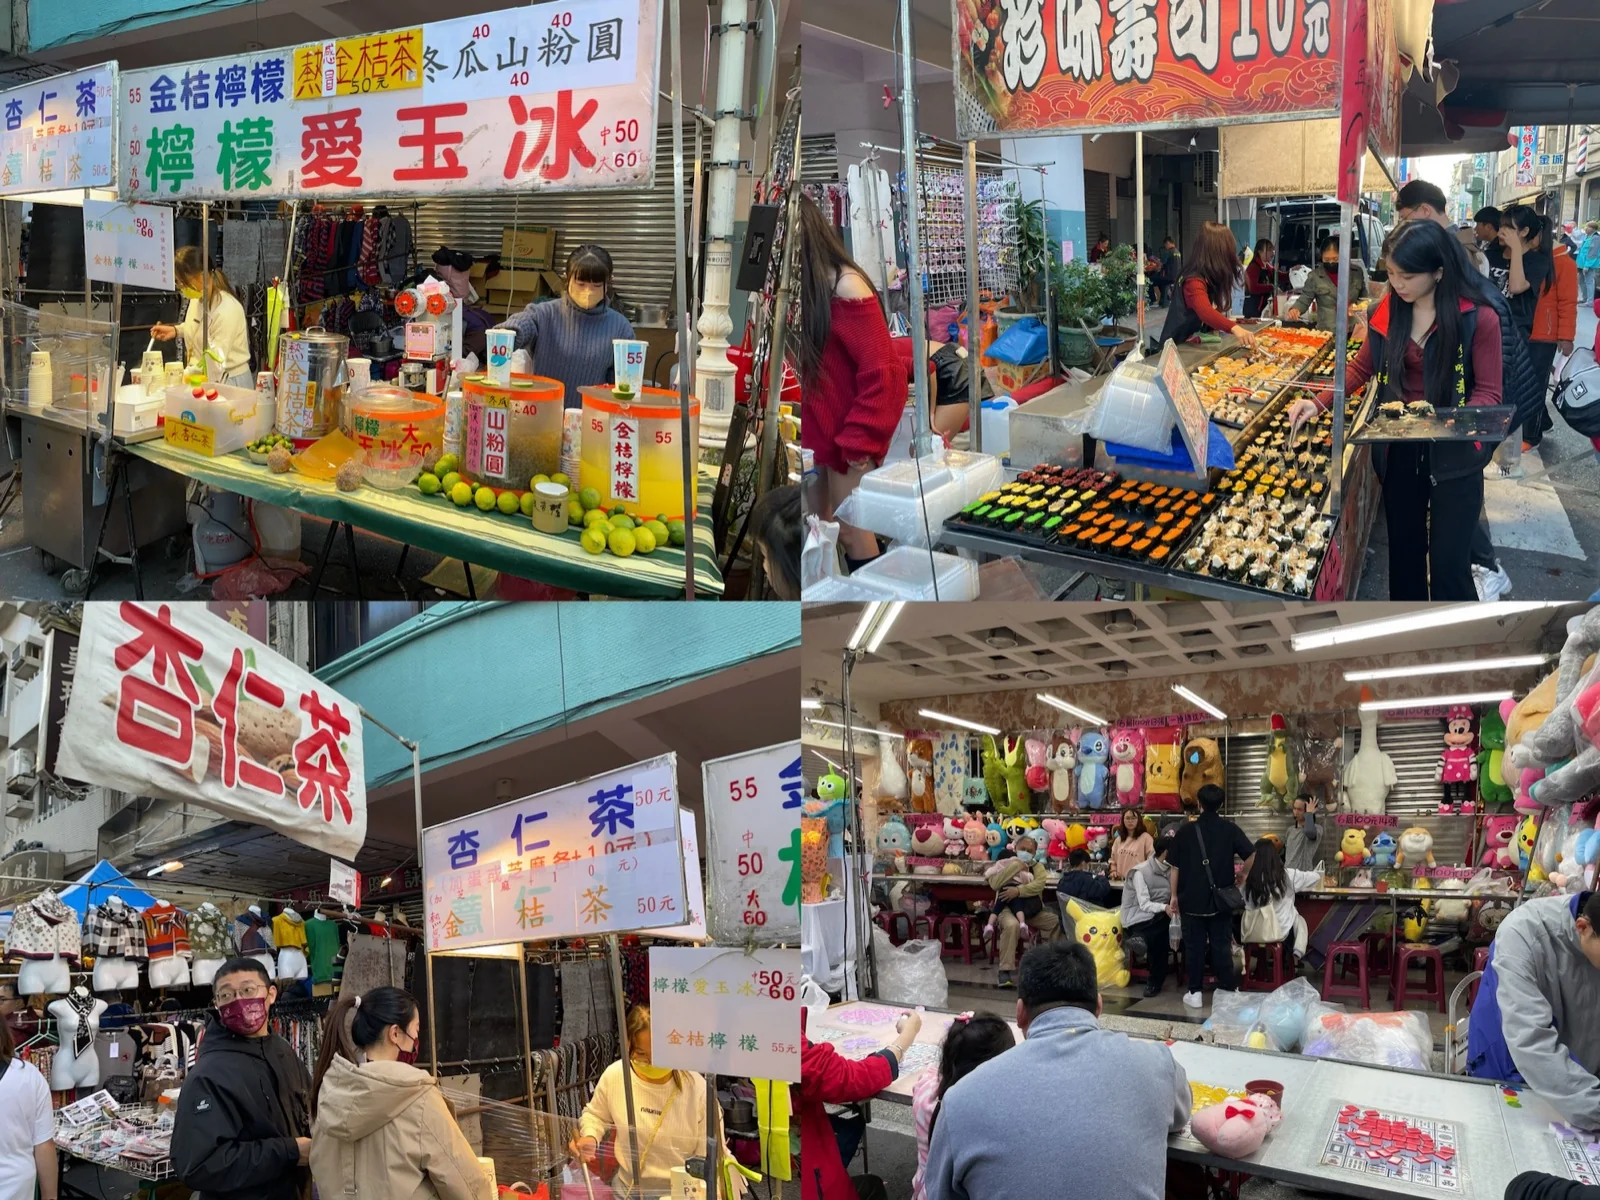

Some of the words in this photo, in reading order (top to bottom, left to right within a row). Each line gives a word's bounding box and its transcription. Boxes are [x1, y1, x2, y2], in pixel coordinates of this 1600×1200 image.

[552, 13, 571, 27] 40
[472, 24, 490, 38] 40
[421, 18, 624, 84] 冬瓜山粉圓
[150, 59, 285, 114] 金桔檸檬
[510, 72, 529, 86] 40
[5, 79, 96, 131] 杏仁茶
[129, 89, 141, 103] 55
[129, 141, 141, 155] 50
[2, 153, 82, 186] 金桔茶
[491, 345, 507, 356] 40
[627, 352, 643, 364] 55
[522, 404, 537, 416] 40
[402, 423, 419, 443] 大
[591, 418, 604, 433] 55
[486, 411, 505, 475] 山粉圓
[655, 431, 672, 444] 55
[613, 421, 636, 498] 金桔檸檬
[114, 600, 354, 825] 杏仁茶
[730, 777, 757, 801] 55
[447, 784, 634, 871] 杏仁茶
[635, 786, 672, 807] 50元
[738, 852, 763, 875] 50
[442, 884, 614, 939] 金桔茶
[637, 895, 675, 914] 50元
[743, 910, 767, 926] 60
[667, 1028, 759, 1053] 金桔檸檬
[772, 1042, 797, 1054] 55元
